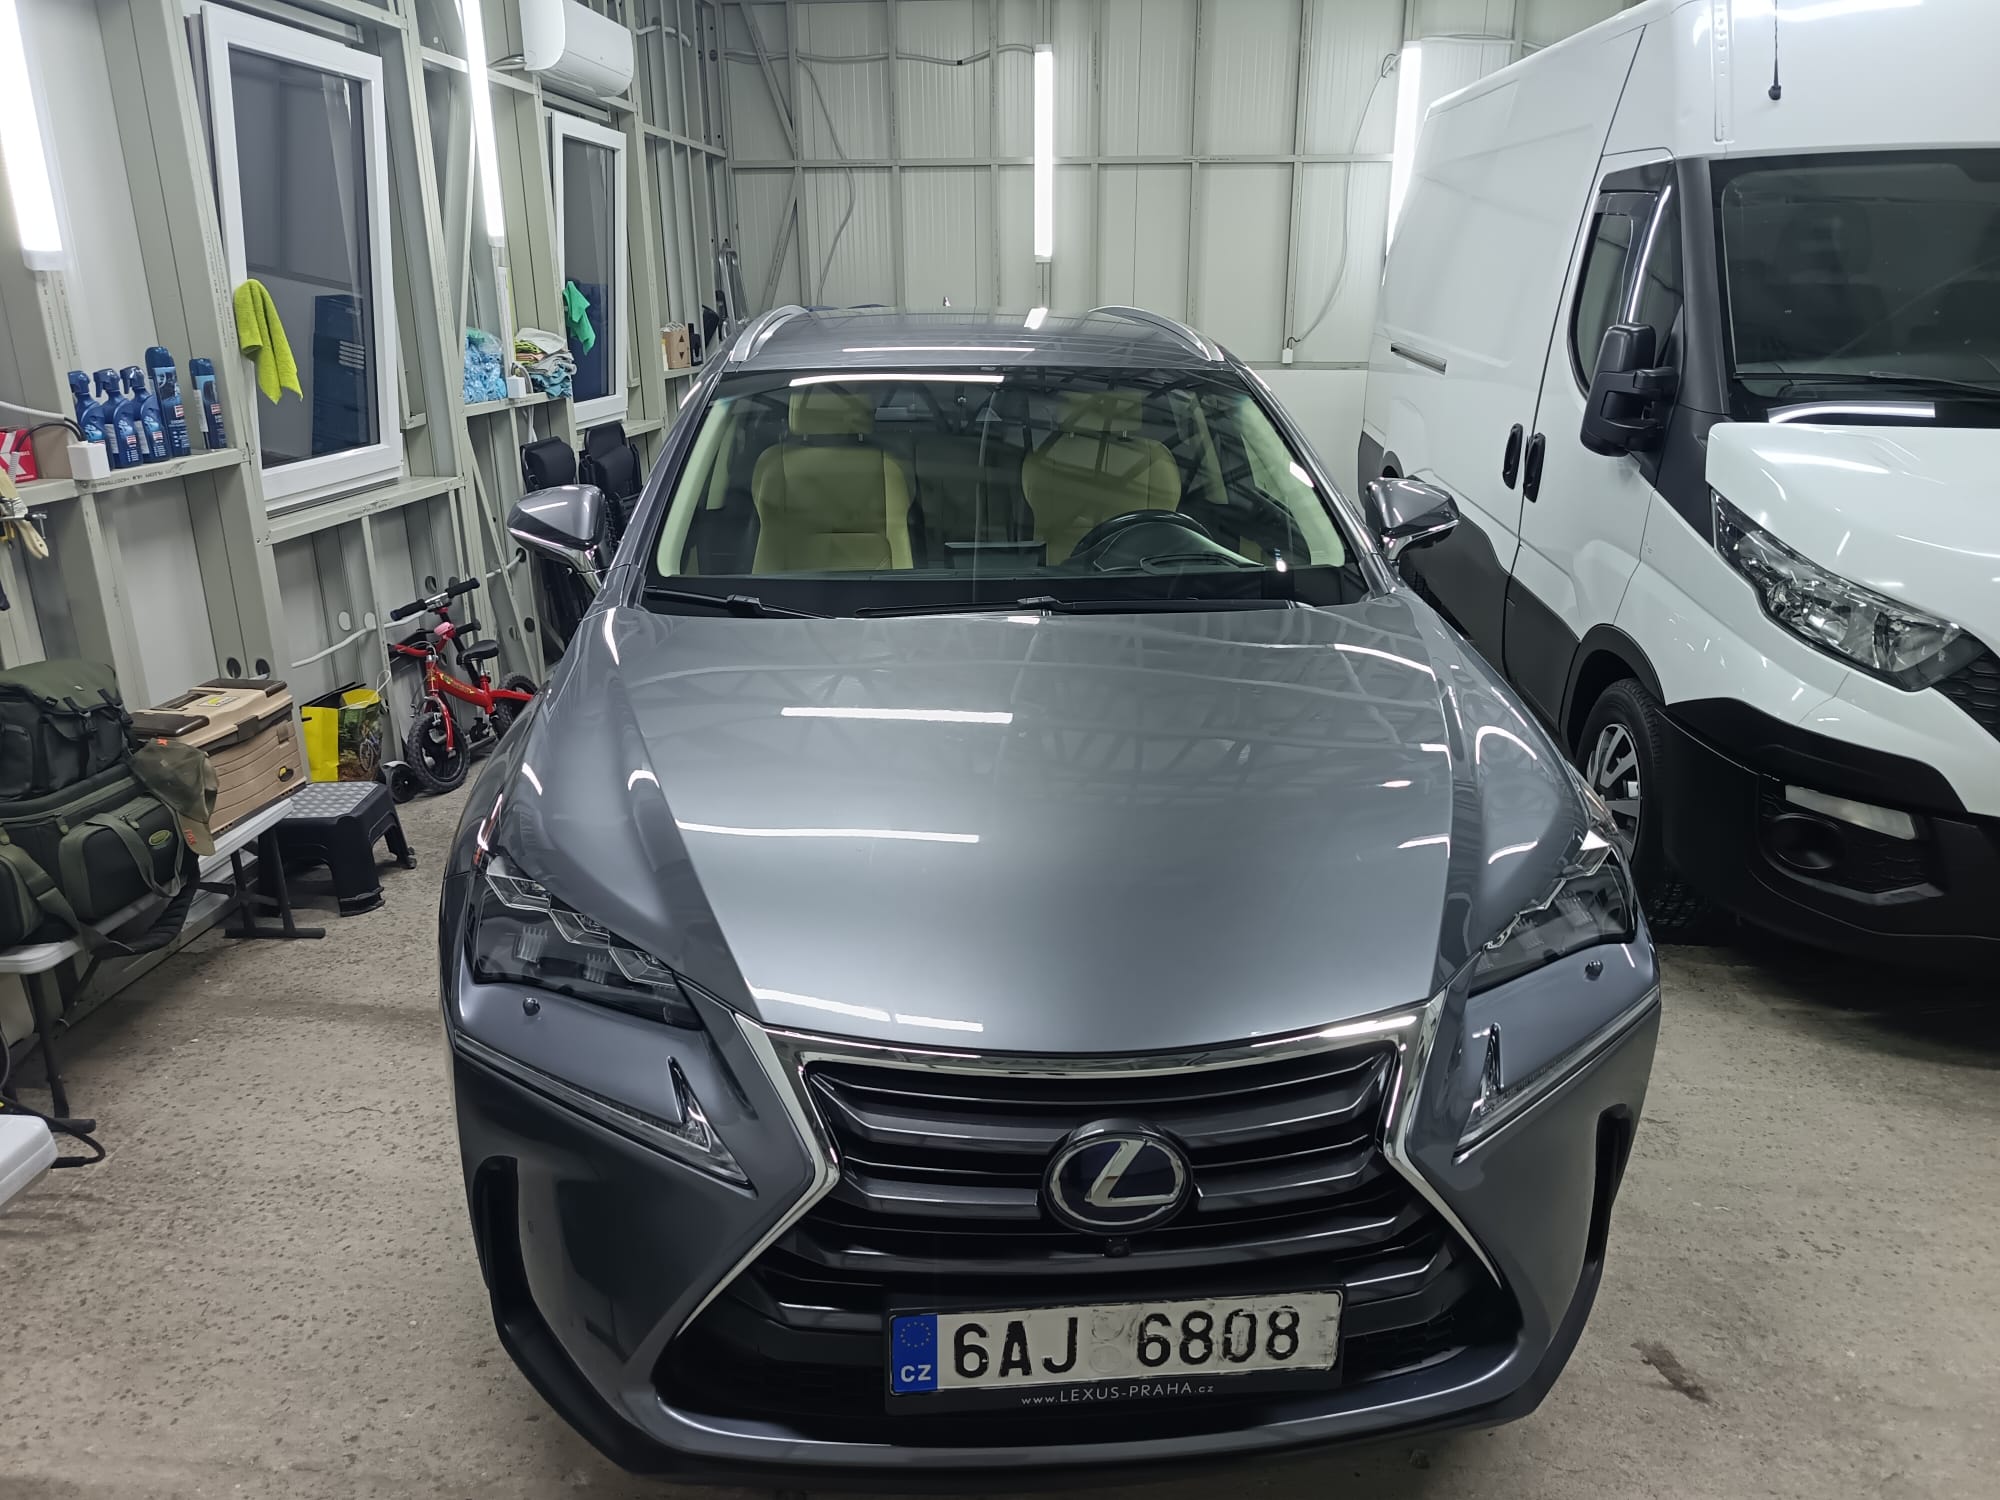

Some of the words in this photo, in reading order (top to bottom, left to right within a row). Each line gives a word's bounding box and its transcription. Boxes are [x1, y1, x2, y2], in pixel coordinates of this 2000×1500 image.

[952, 1317, 1079, 1379] 6AJ
[1136, 1305, 1300, 1368] 6808
[900, 1364, 932, 1383] CZ
[1021, 1382, 1214, 1405] www.LEXUS-PRAHA.cz
